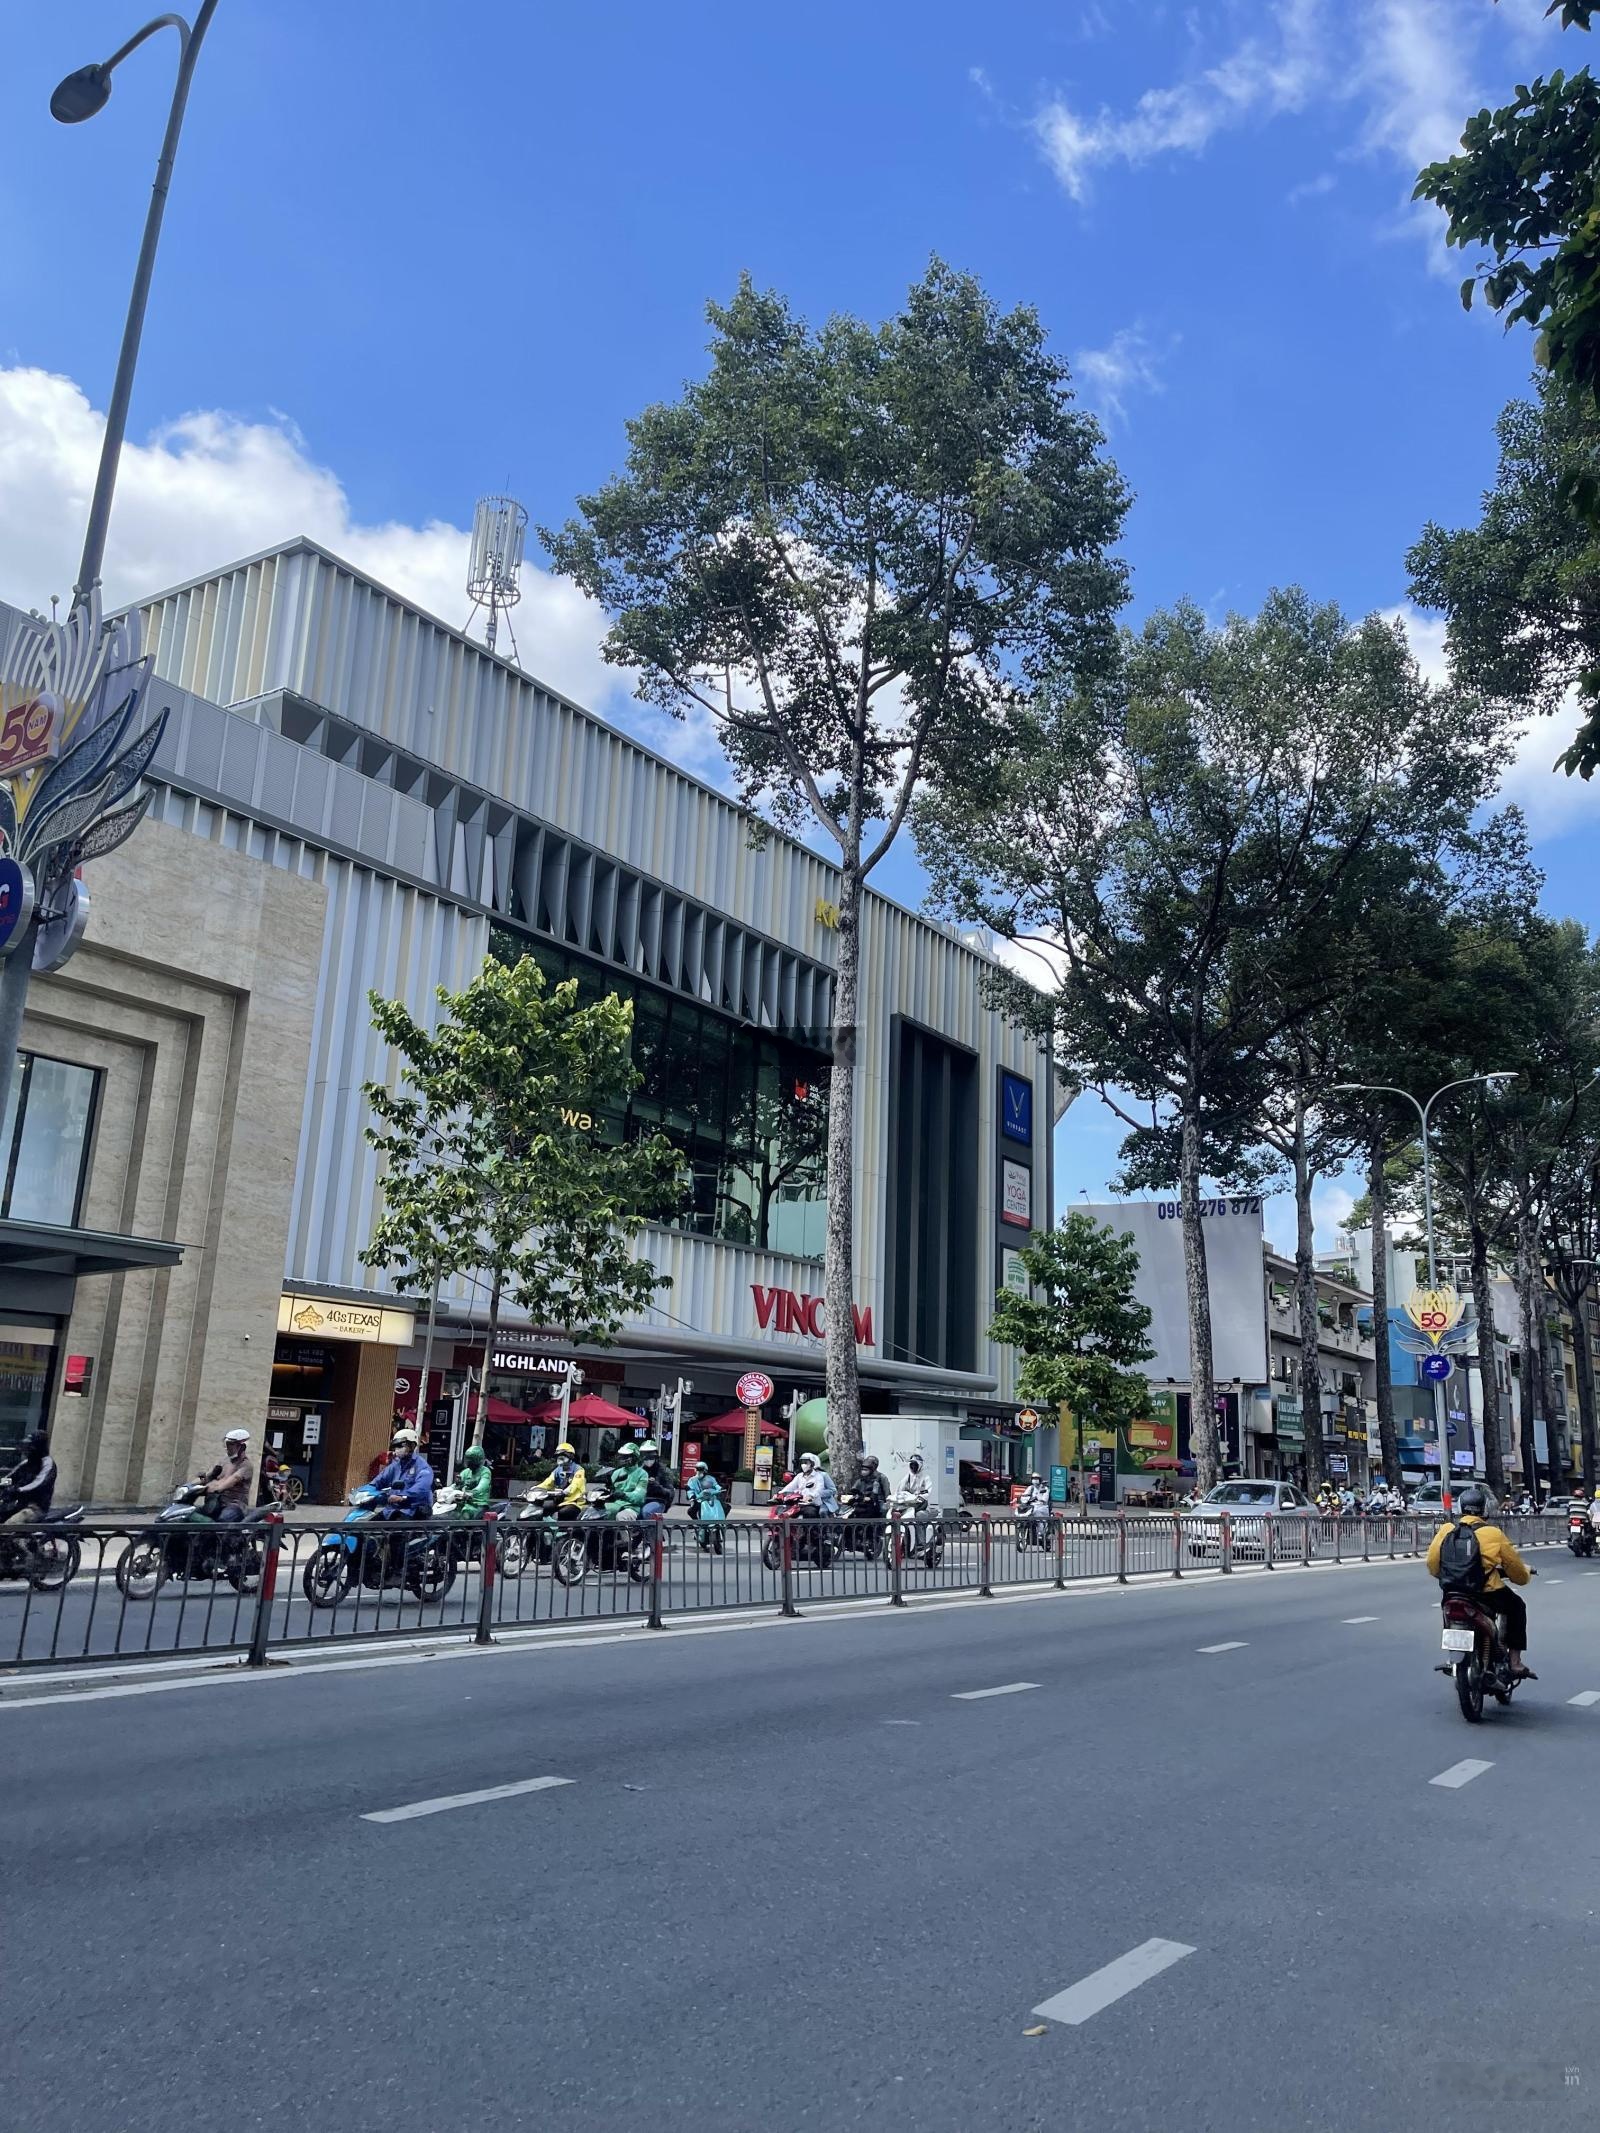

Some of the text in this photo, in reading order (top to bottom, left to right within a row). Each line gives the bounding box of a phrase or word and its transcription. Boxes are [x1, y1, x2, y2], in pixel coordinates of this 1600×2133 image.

[0, 694, 54, 762] 50
[1007, 1183, 1026, 1201] YOGA
[1006, 1198, 1027, 1214] CENTER
[1158, 1198, 1260, 1220] 096 276 872
[750, 1284, 876, 1346] VINCM
[1421, 1312, 1447, 1327] 50
[339, 1326, 365, 1334] BAKERY
[492, 1353, 577, 1374] HIGHLANDS
[739, 1374, 769, 1387] HIGHLANDS
[741, 1396, 765, 1405] COFFEE
